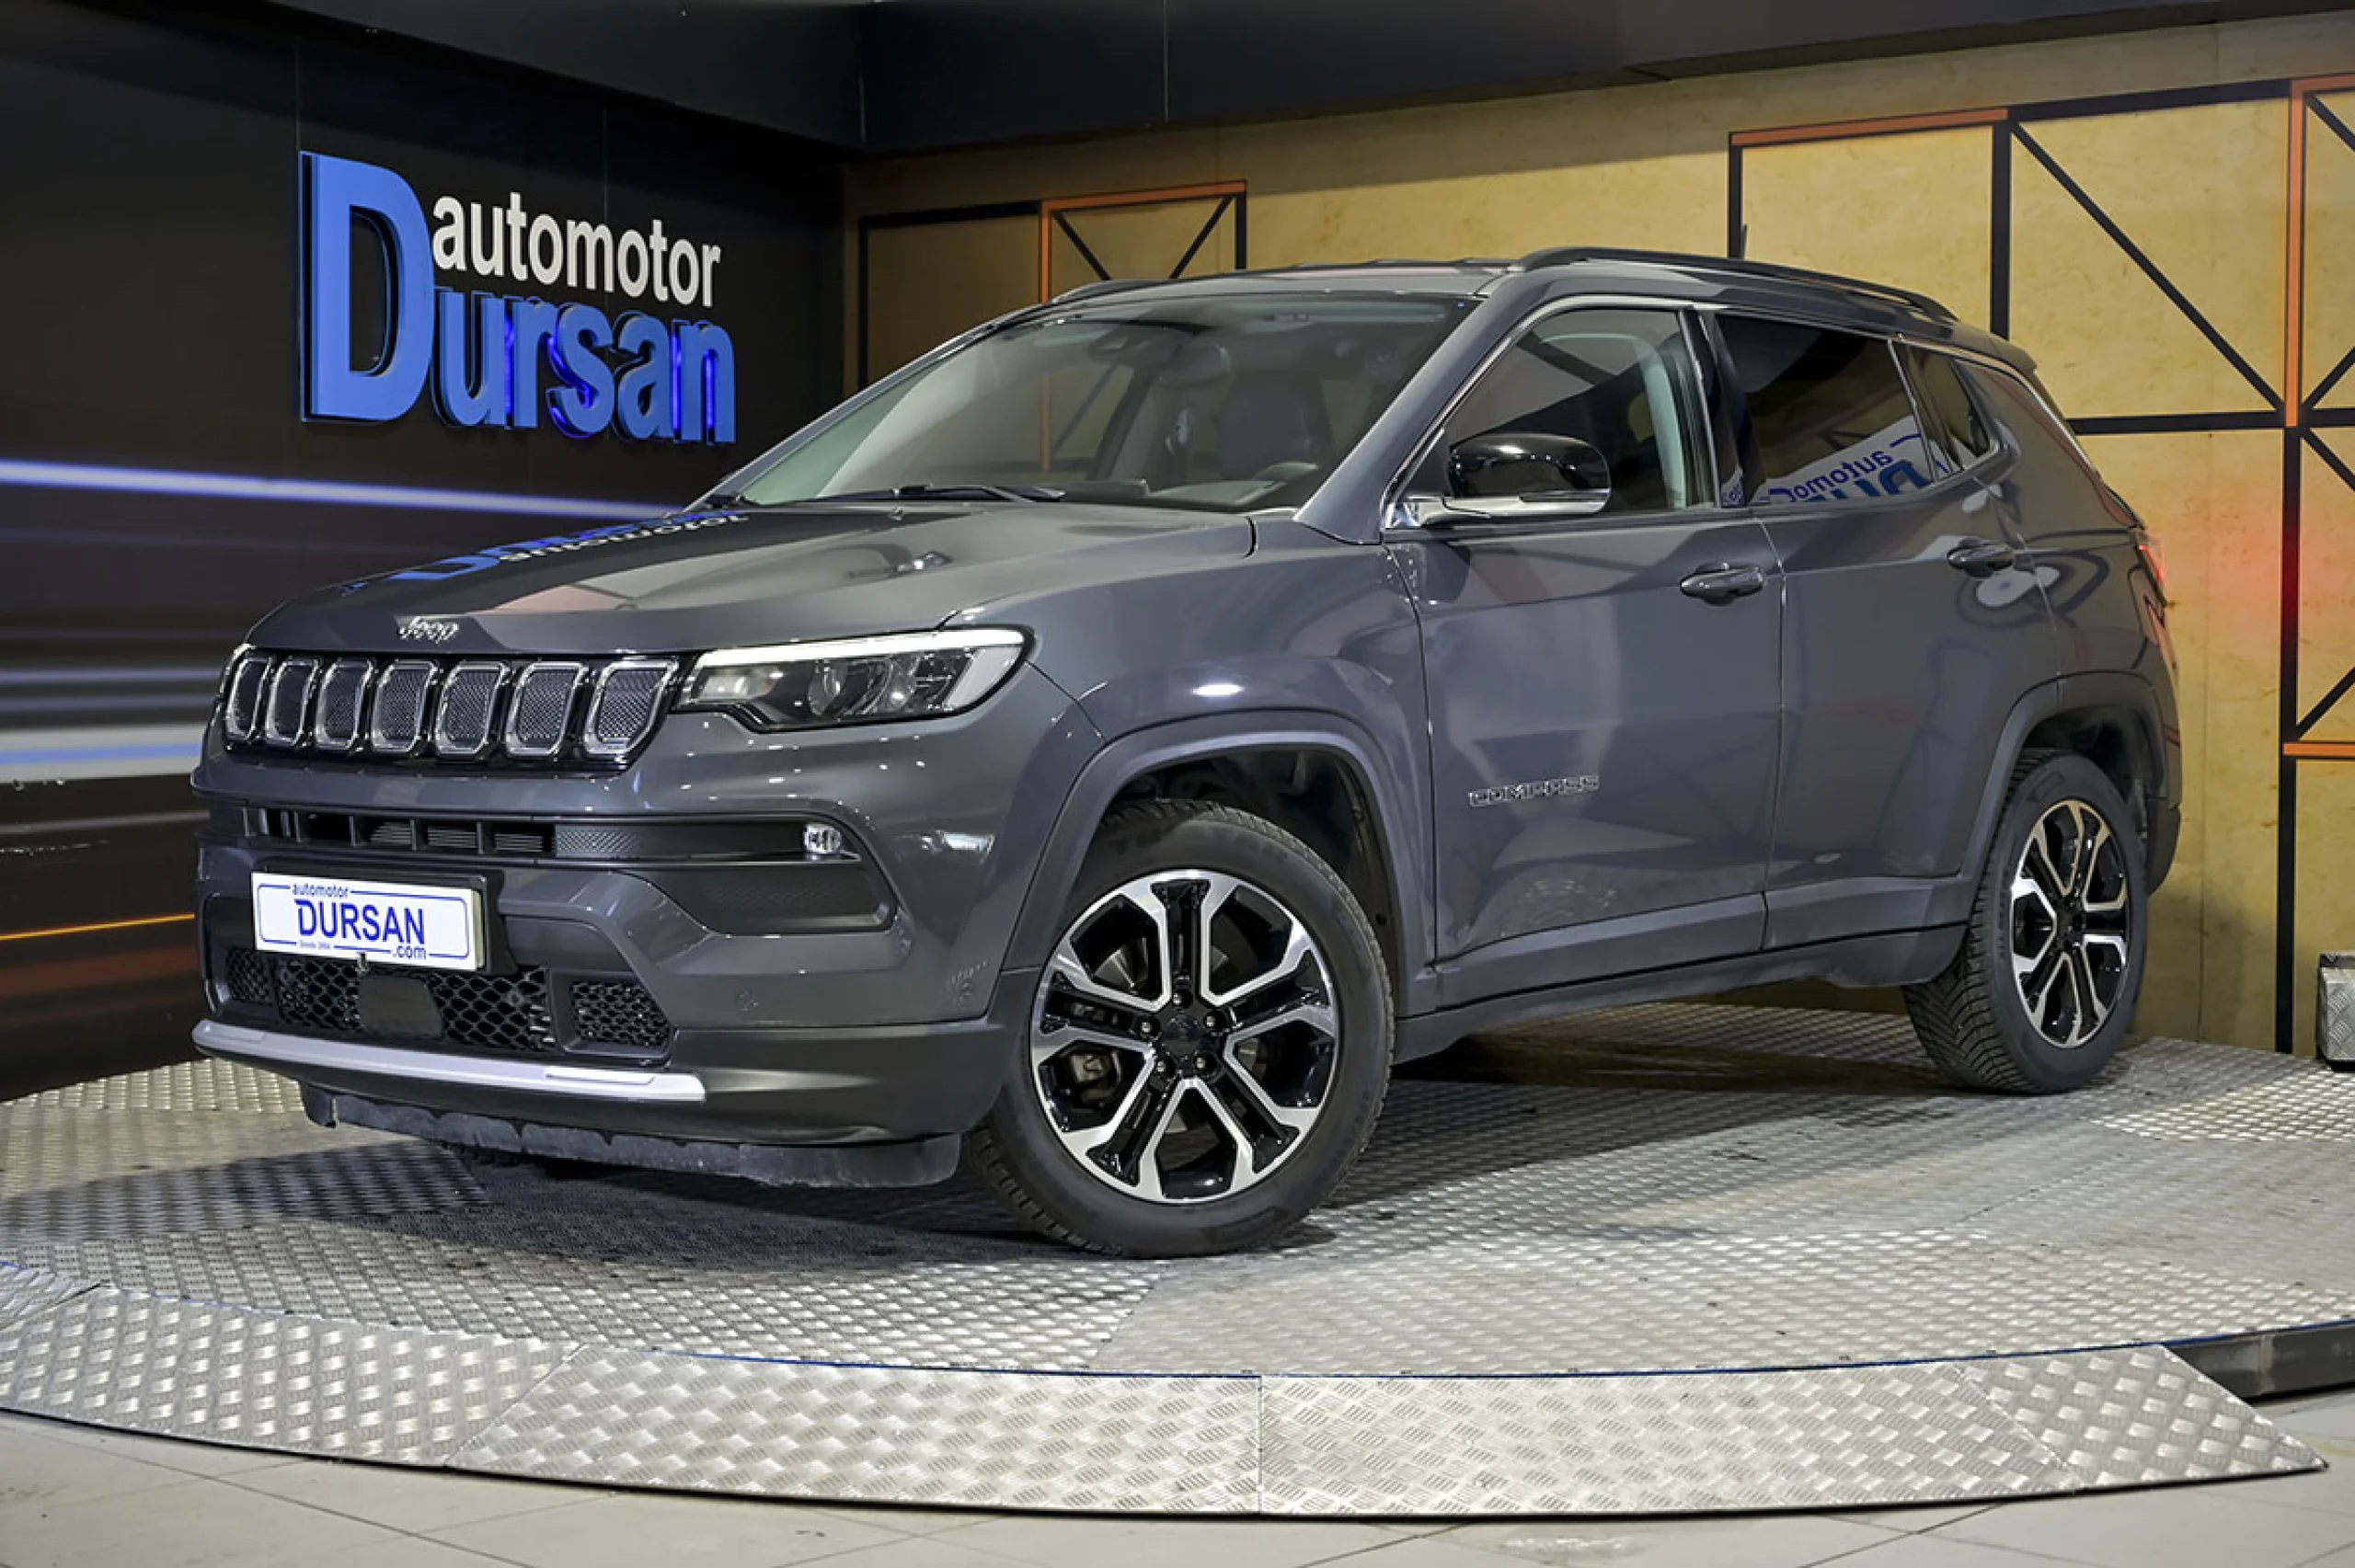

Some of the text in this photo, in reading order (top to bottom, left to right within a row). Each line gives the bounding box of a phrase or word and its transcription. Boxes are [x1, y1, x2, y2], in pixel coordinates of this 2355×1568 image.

[431, 191, 721, 307] automotor
[299, 150, 736, 443] Dursan
[292, 883, 350, 898] automotor
[294, 898, 426, 945] DURSAN
[392, 944, 427, 960] .com
